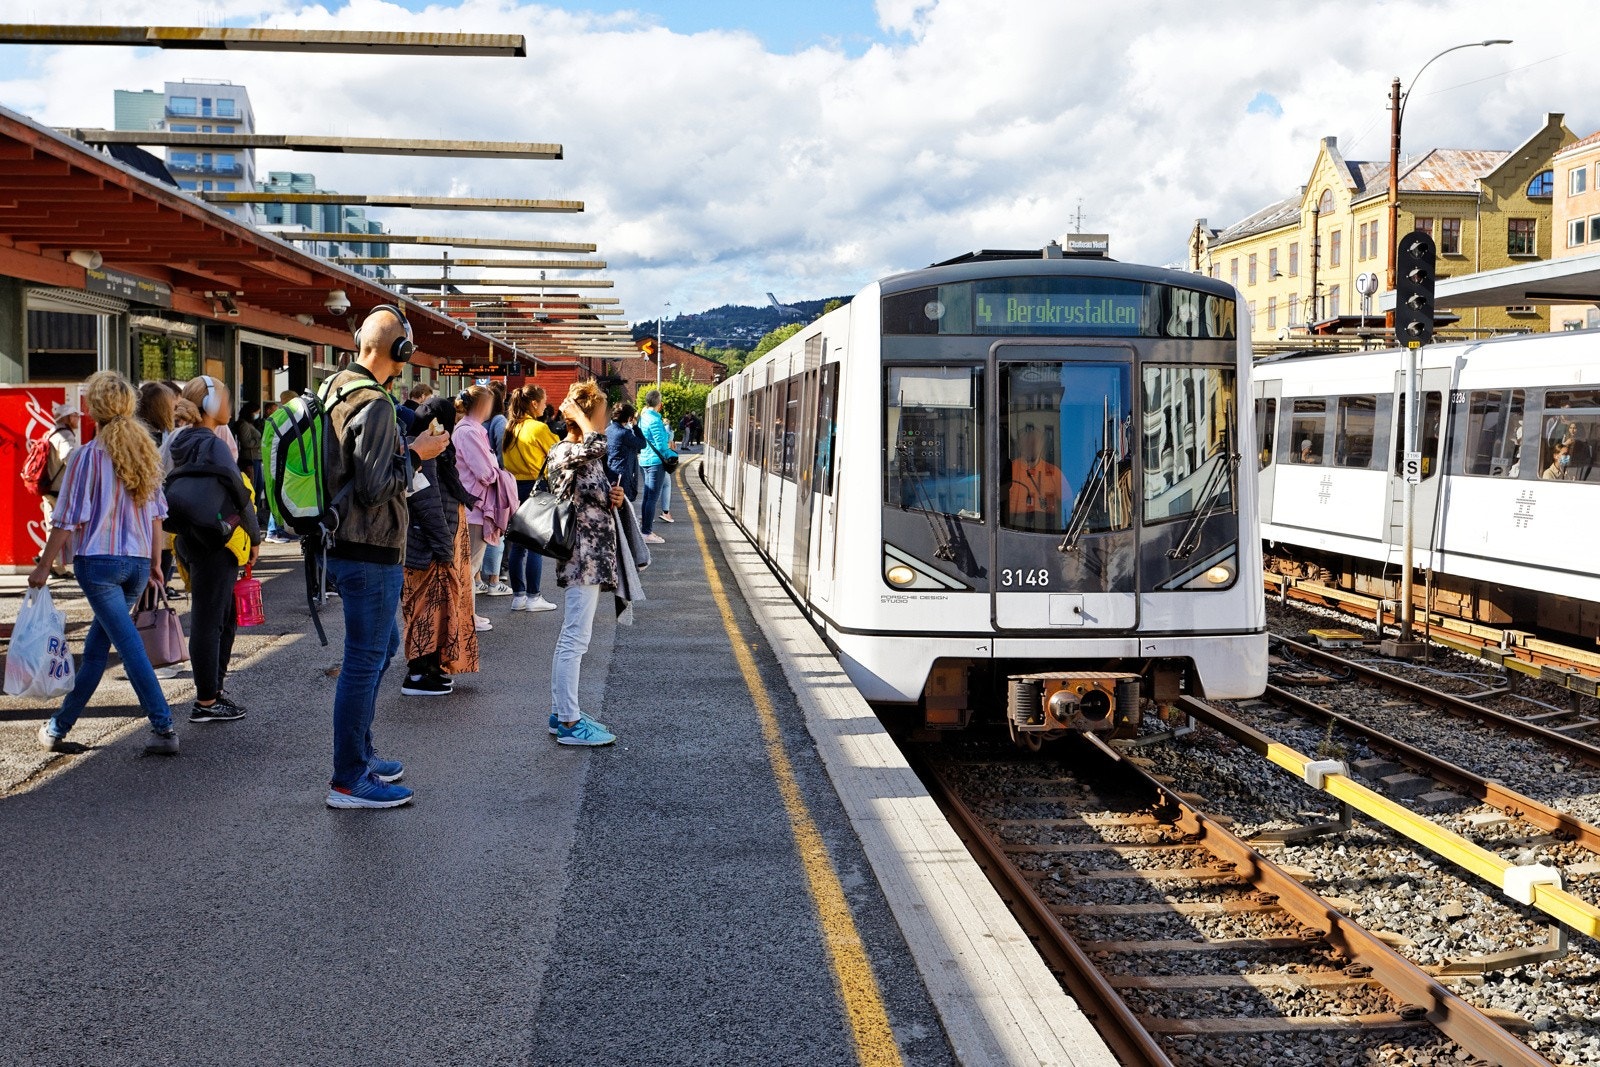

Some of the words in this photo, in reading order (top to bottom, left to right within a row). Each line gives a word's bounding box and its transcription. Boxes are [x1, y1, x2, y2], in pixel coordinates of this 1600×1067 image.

[1359, 278, 1366, 291] T
[978, 297, 993, 323] 4
[1007, 297, 1136, 324] Bergkrystallen
[1407, 461, 1418, 475] S
[1001, 569, 1049, 587] 3148
